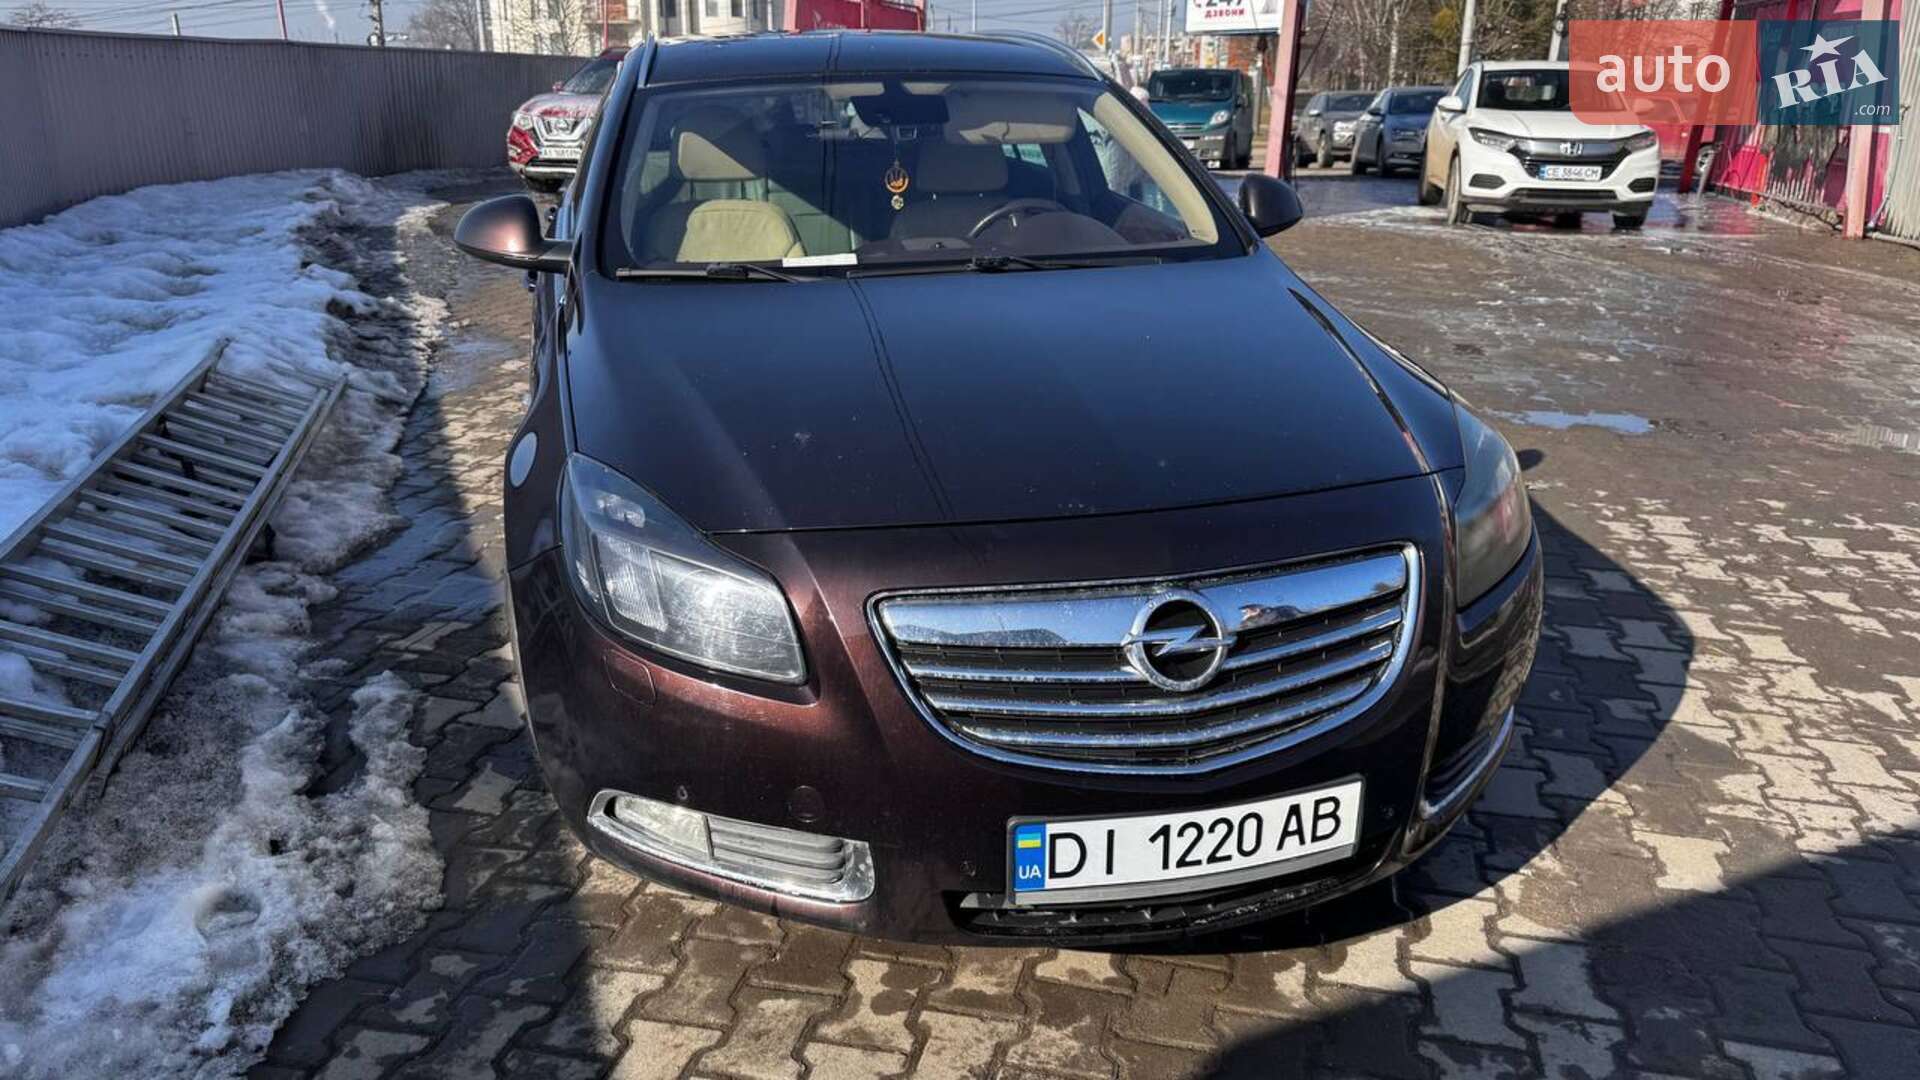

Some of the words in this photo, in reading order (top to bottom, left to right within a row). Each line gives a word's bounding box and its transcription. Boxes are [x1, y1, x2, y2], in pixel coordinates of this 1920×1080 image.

[1204, 9, 1245, 18] ДЗВОНИ
[1547, 167, 1560, 178] CE
[1585, 167, 1598, 179] CM
[1048, 829, 1116, 880] DI
[1149, 812, 1263, 871] 1220
[1276, 796, 1341, 852] AB
[1018, 864, 1043, 880] UA
